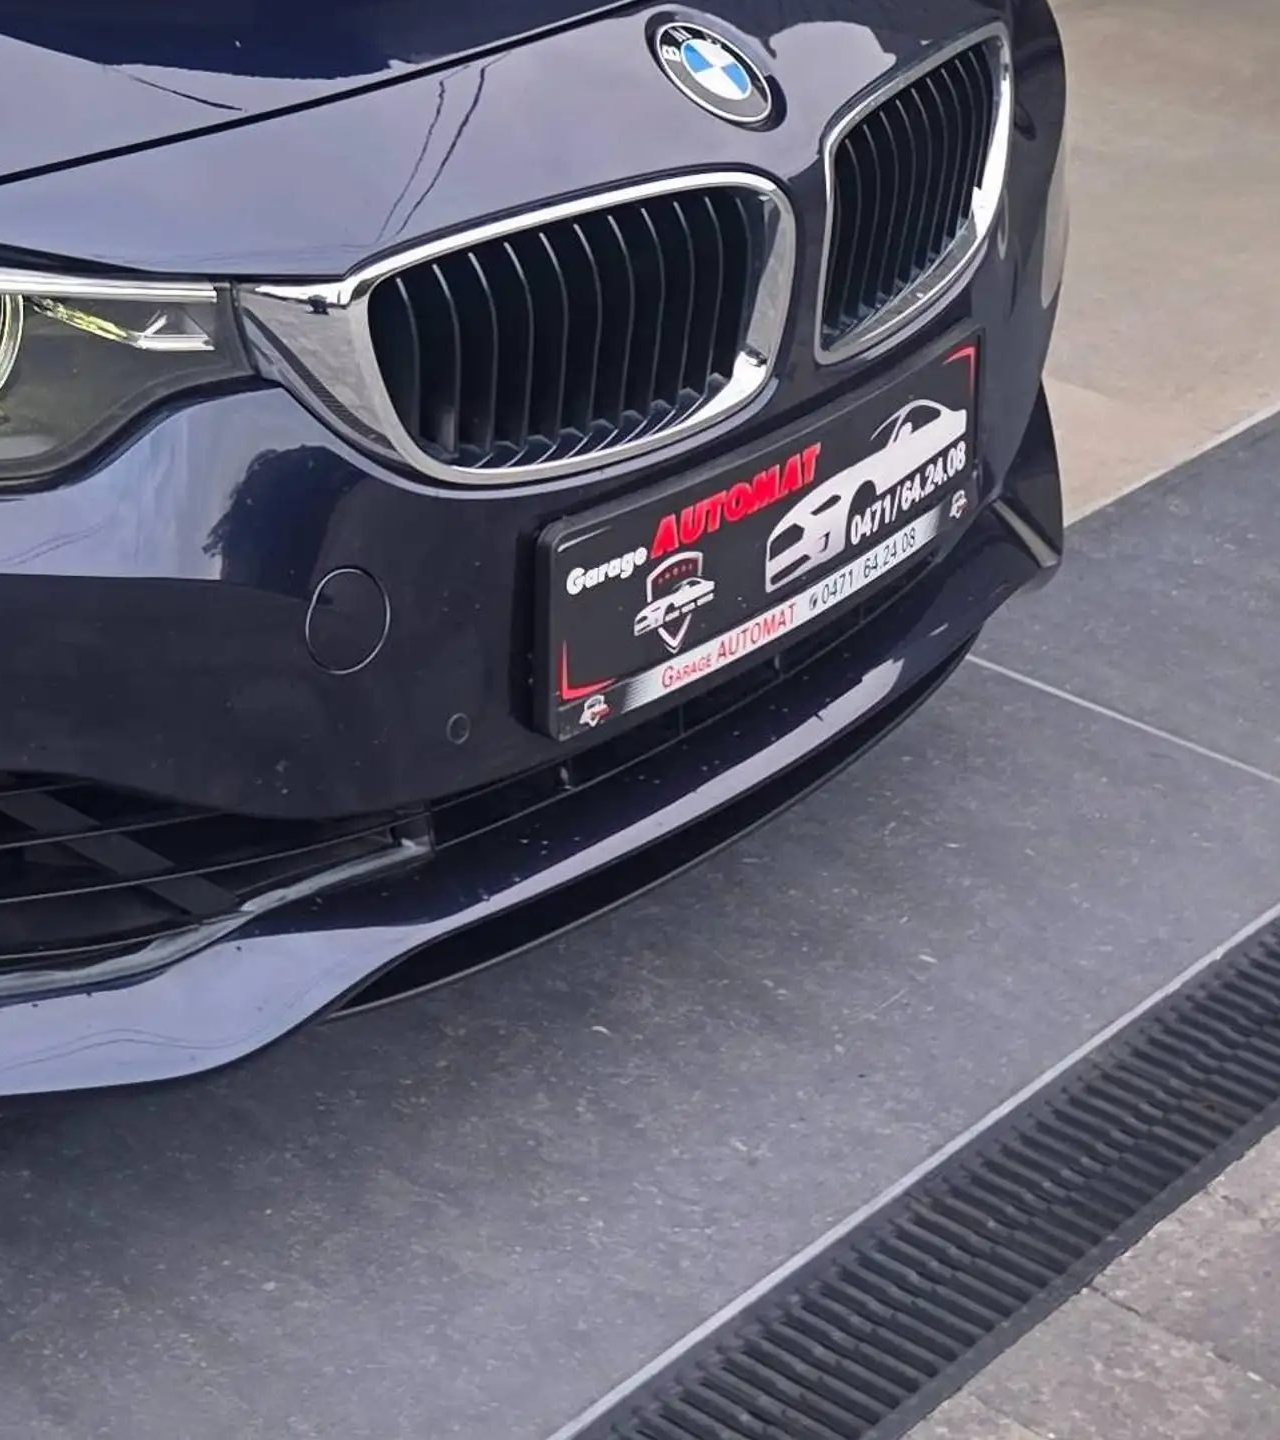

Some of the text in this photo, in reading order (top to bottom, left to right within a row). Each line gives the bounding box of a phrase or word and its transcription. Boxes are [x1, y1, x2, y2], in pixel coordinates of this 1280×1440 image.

[566, 442, 821, 595] Garage AUTOMAT
[850, 440, 966, 545] 0471/64.24.08
[717, 603, 798, 661] AUTOMAT
